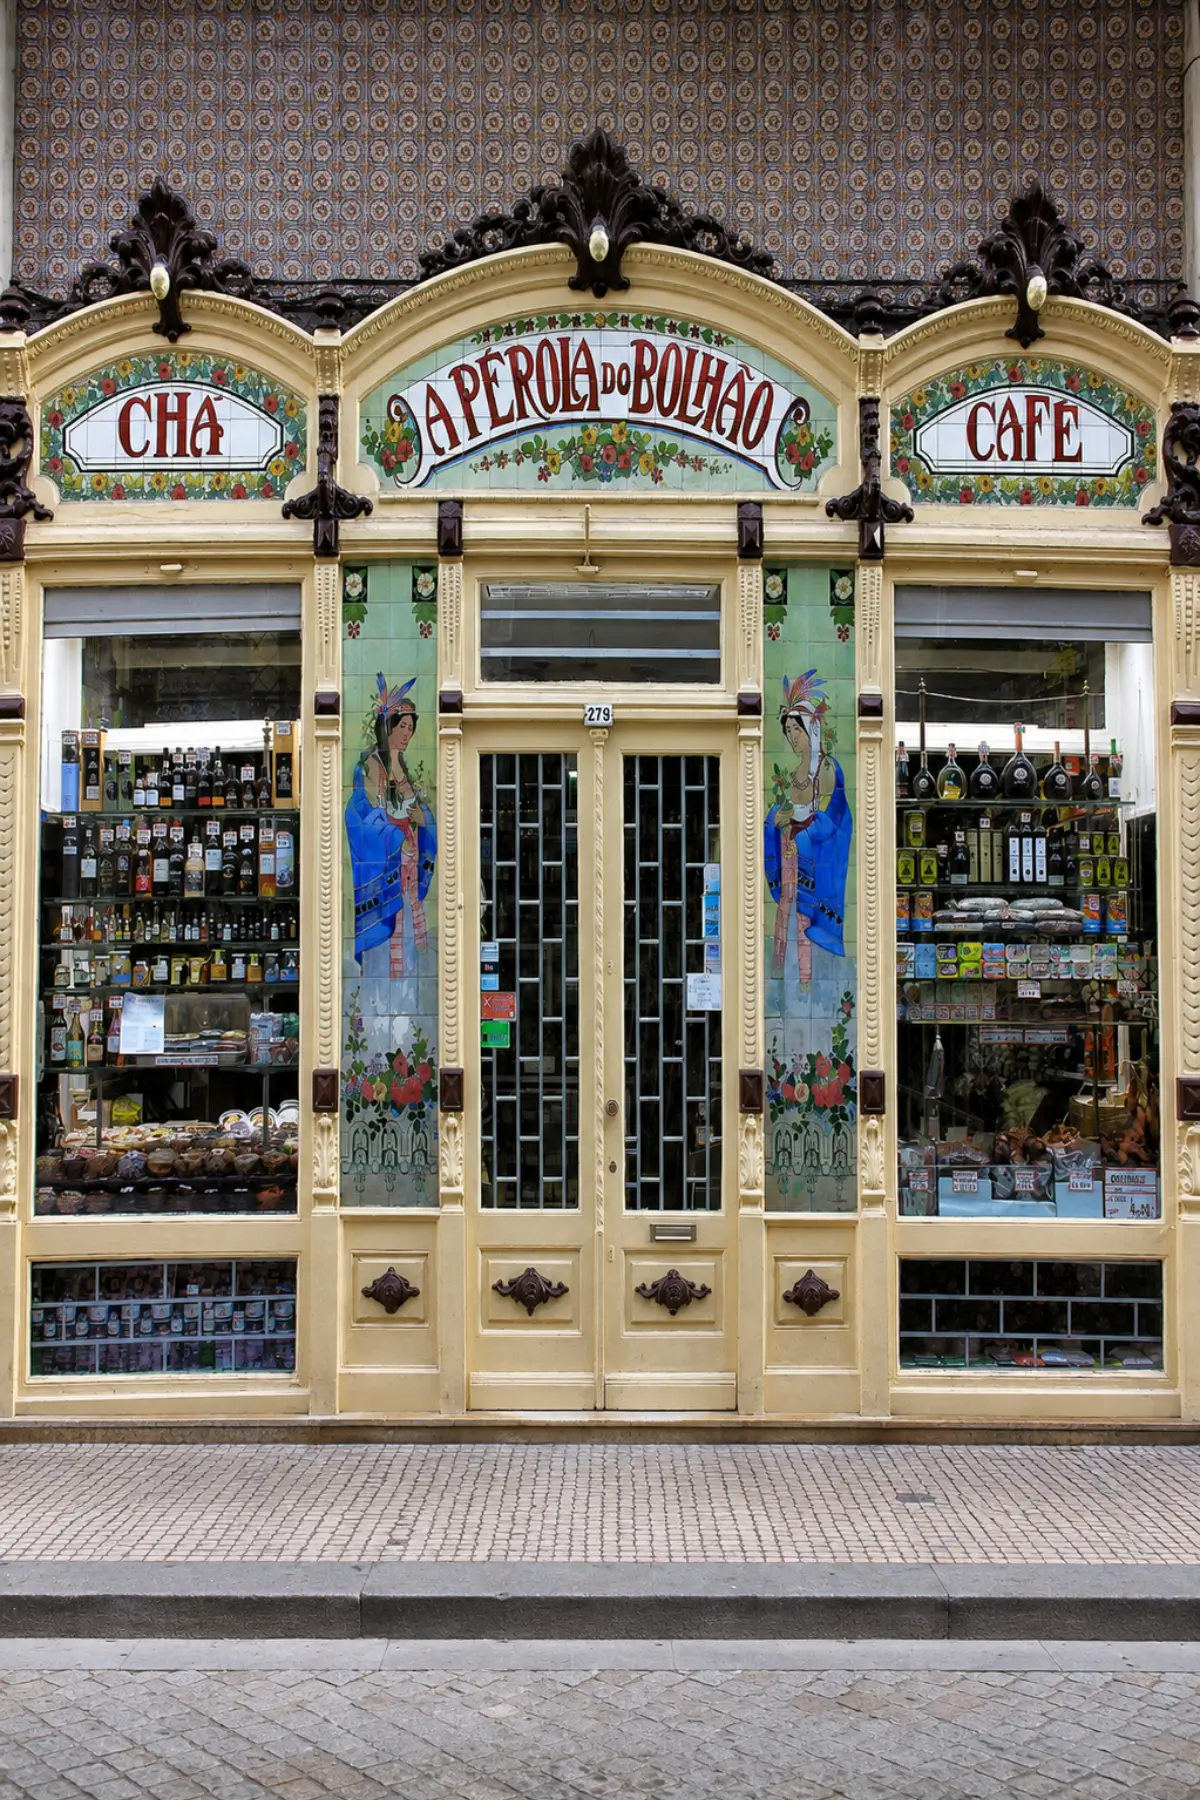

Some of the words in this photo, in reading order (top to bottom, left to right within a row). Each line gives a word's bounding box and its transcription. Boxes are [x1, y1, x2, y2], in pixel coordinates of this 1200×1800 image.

[426, 383, 461, 456] A
[448, 337, 600, 440] PÉROLA
[600, 362, 631, 396] DO
[629, 338, 774, 450] BOLHÃO
[587, 706, 611, 722] 279
